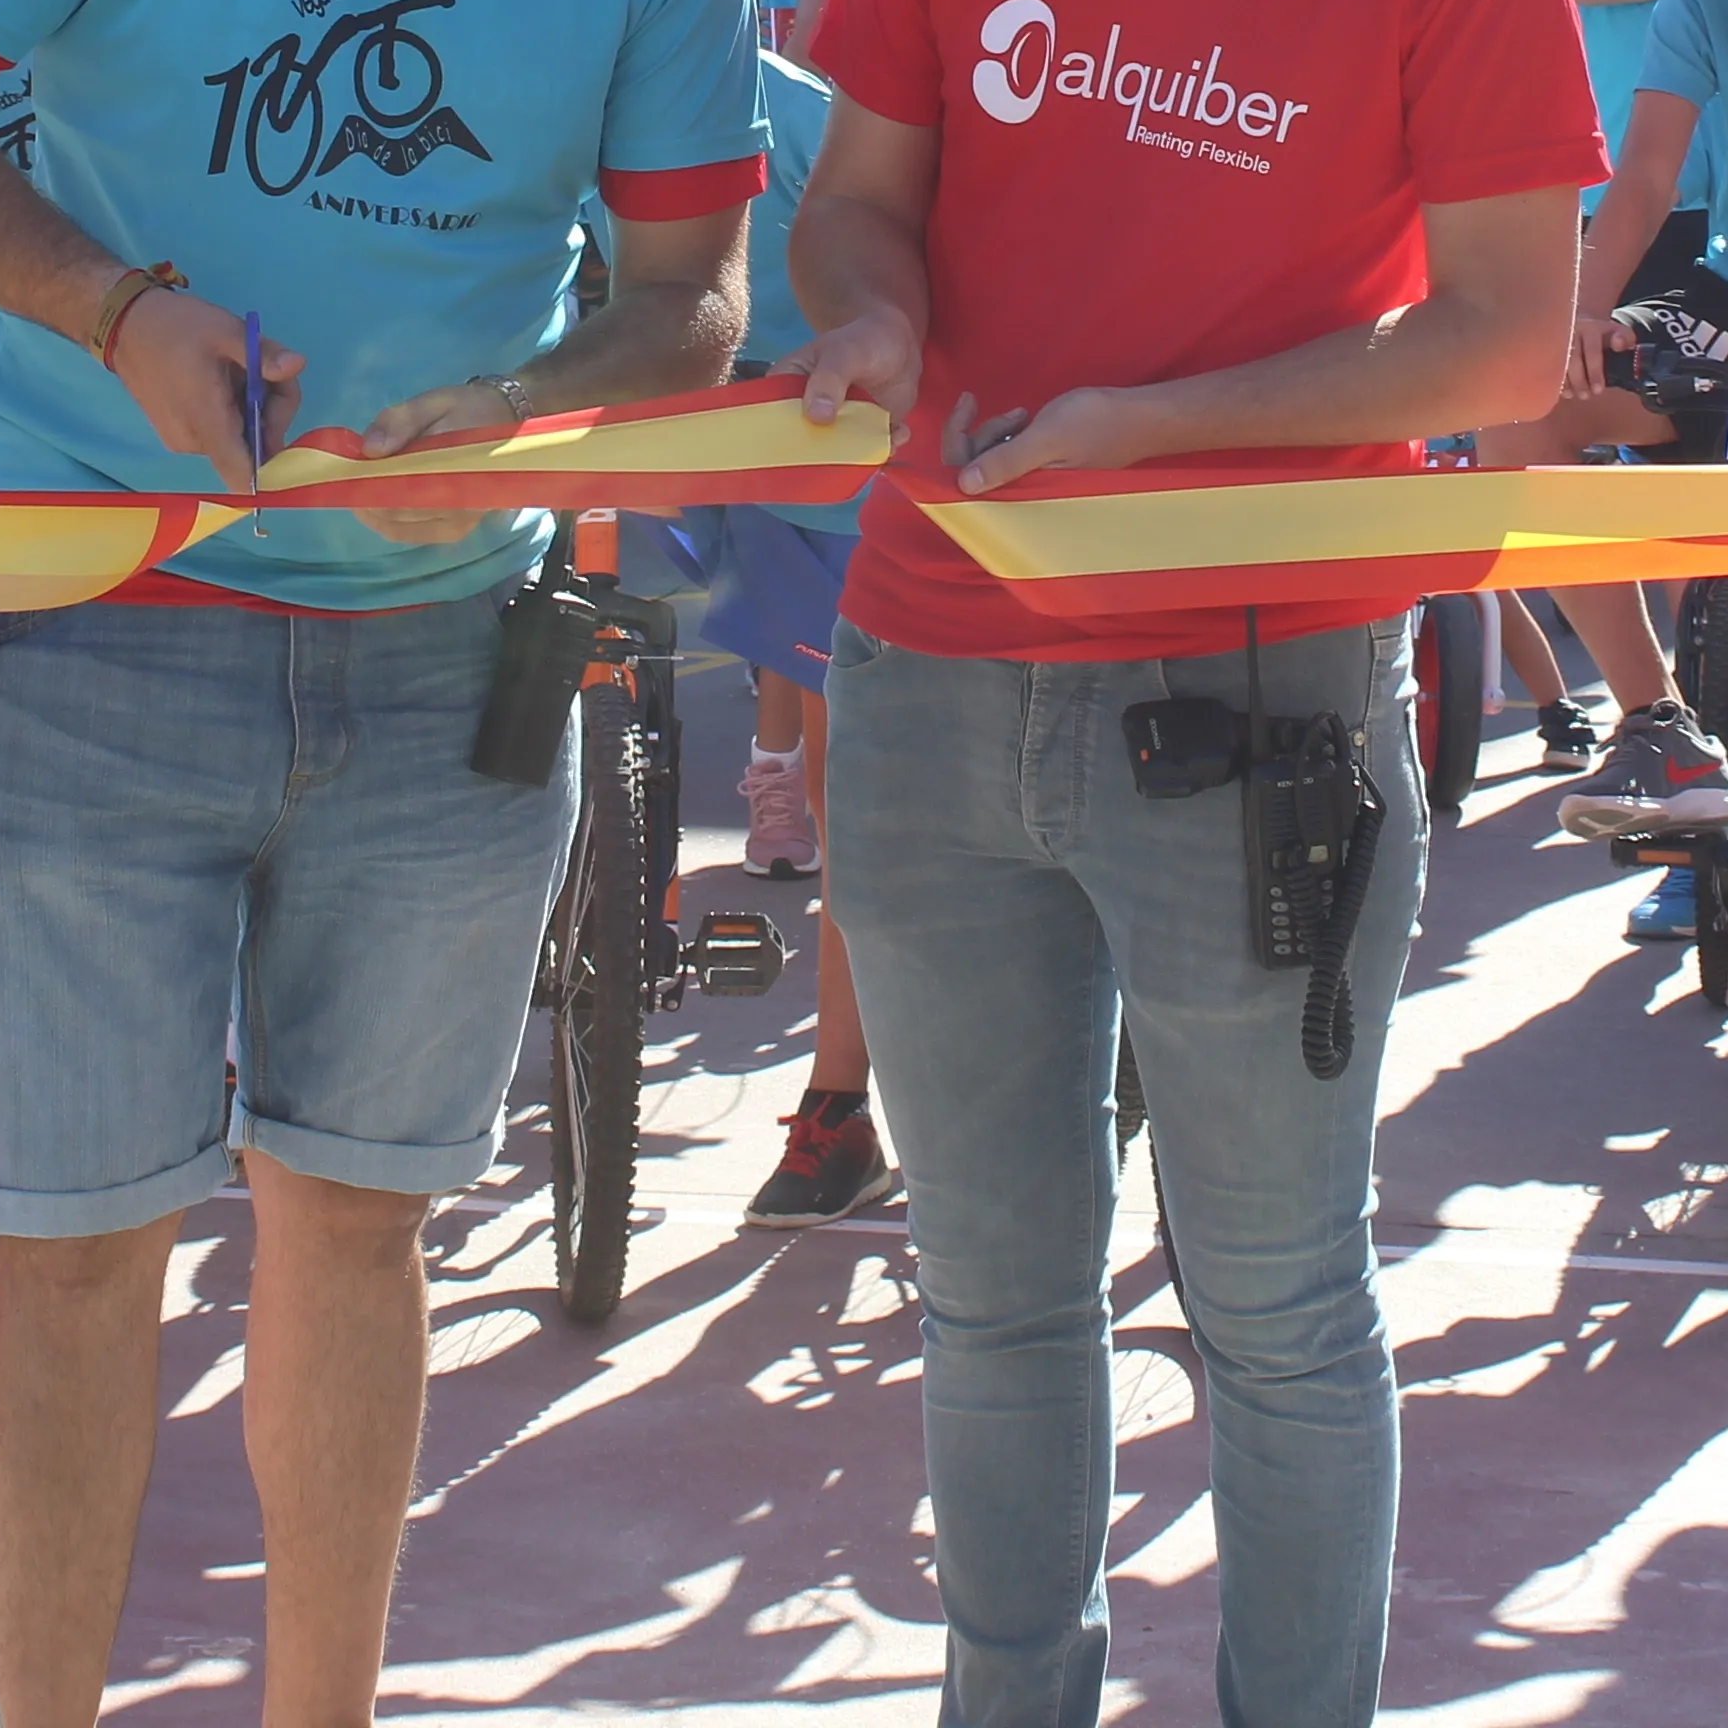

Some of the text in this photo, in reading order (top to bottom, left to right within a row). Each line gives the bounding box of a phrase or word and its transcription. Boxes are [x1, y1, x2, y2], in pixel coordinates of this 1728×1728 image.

[1055, 23, 1309, 144] alquiber
[1134, 125, 1272, 175] Renting Flexible
